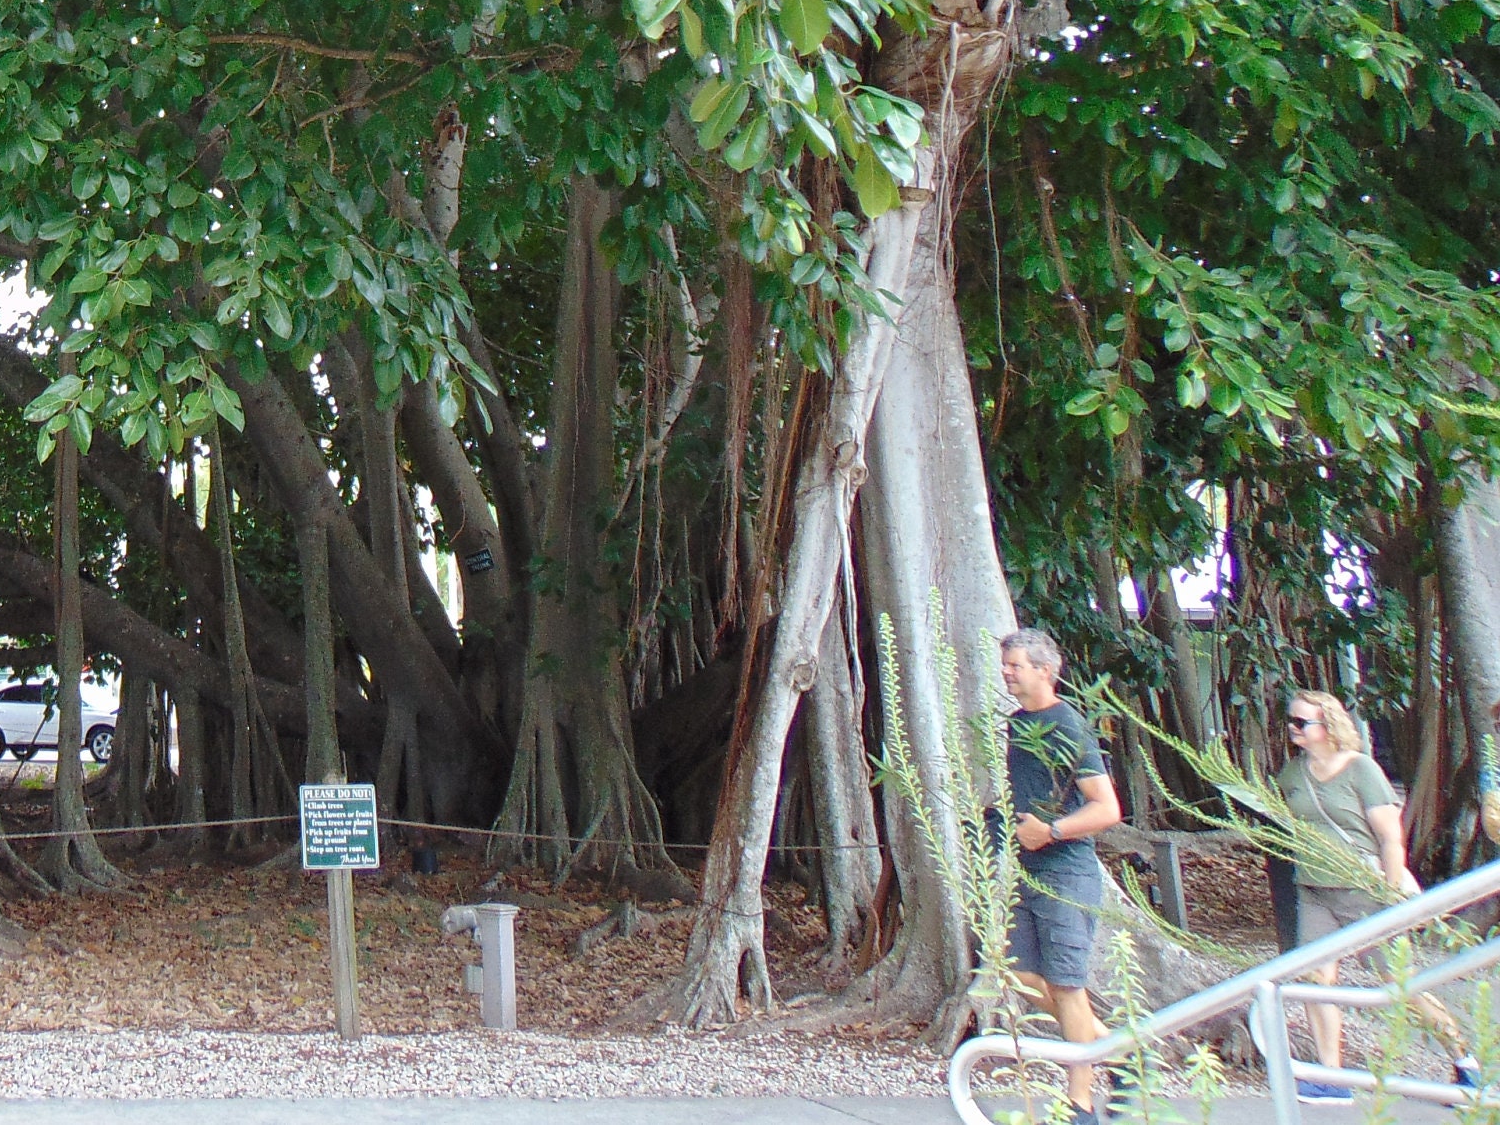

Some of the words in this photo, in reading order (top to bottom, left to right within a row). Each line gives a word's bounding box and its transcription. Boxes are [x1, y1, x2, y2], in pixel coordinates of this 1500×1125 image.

[304, 789, 336, 798] PLEASE
[337, 789, 351, 798] DO
[308, 801, 327, 809] Climb
[308, 810, 323, 818] Pick
[323, 810, 346, 818] flowers
[355, 810, 373, 818] fruits
[311, 818, 327, 827] from
[353, 818, 372, 828] plants
[309, 828, 323, 836] Pick
[324, 829, 334, 837] up
[334, 828, 352, 836] fruits
[312, 836, 323, 844] the
[324, 836, 347, 846] ground
[309, 845, 324, 854] Step
[340, 853, 360, 865] Thank
[361, 854, 376, 864] You
